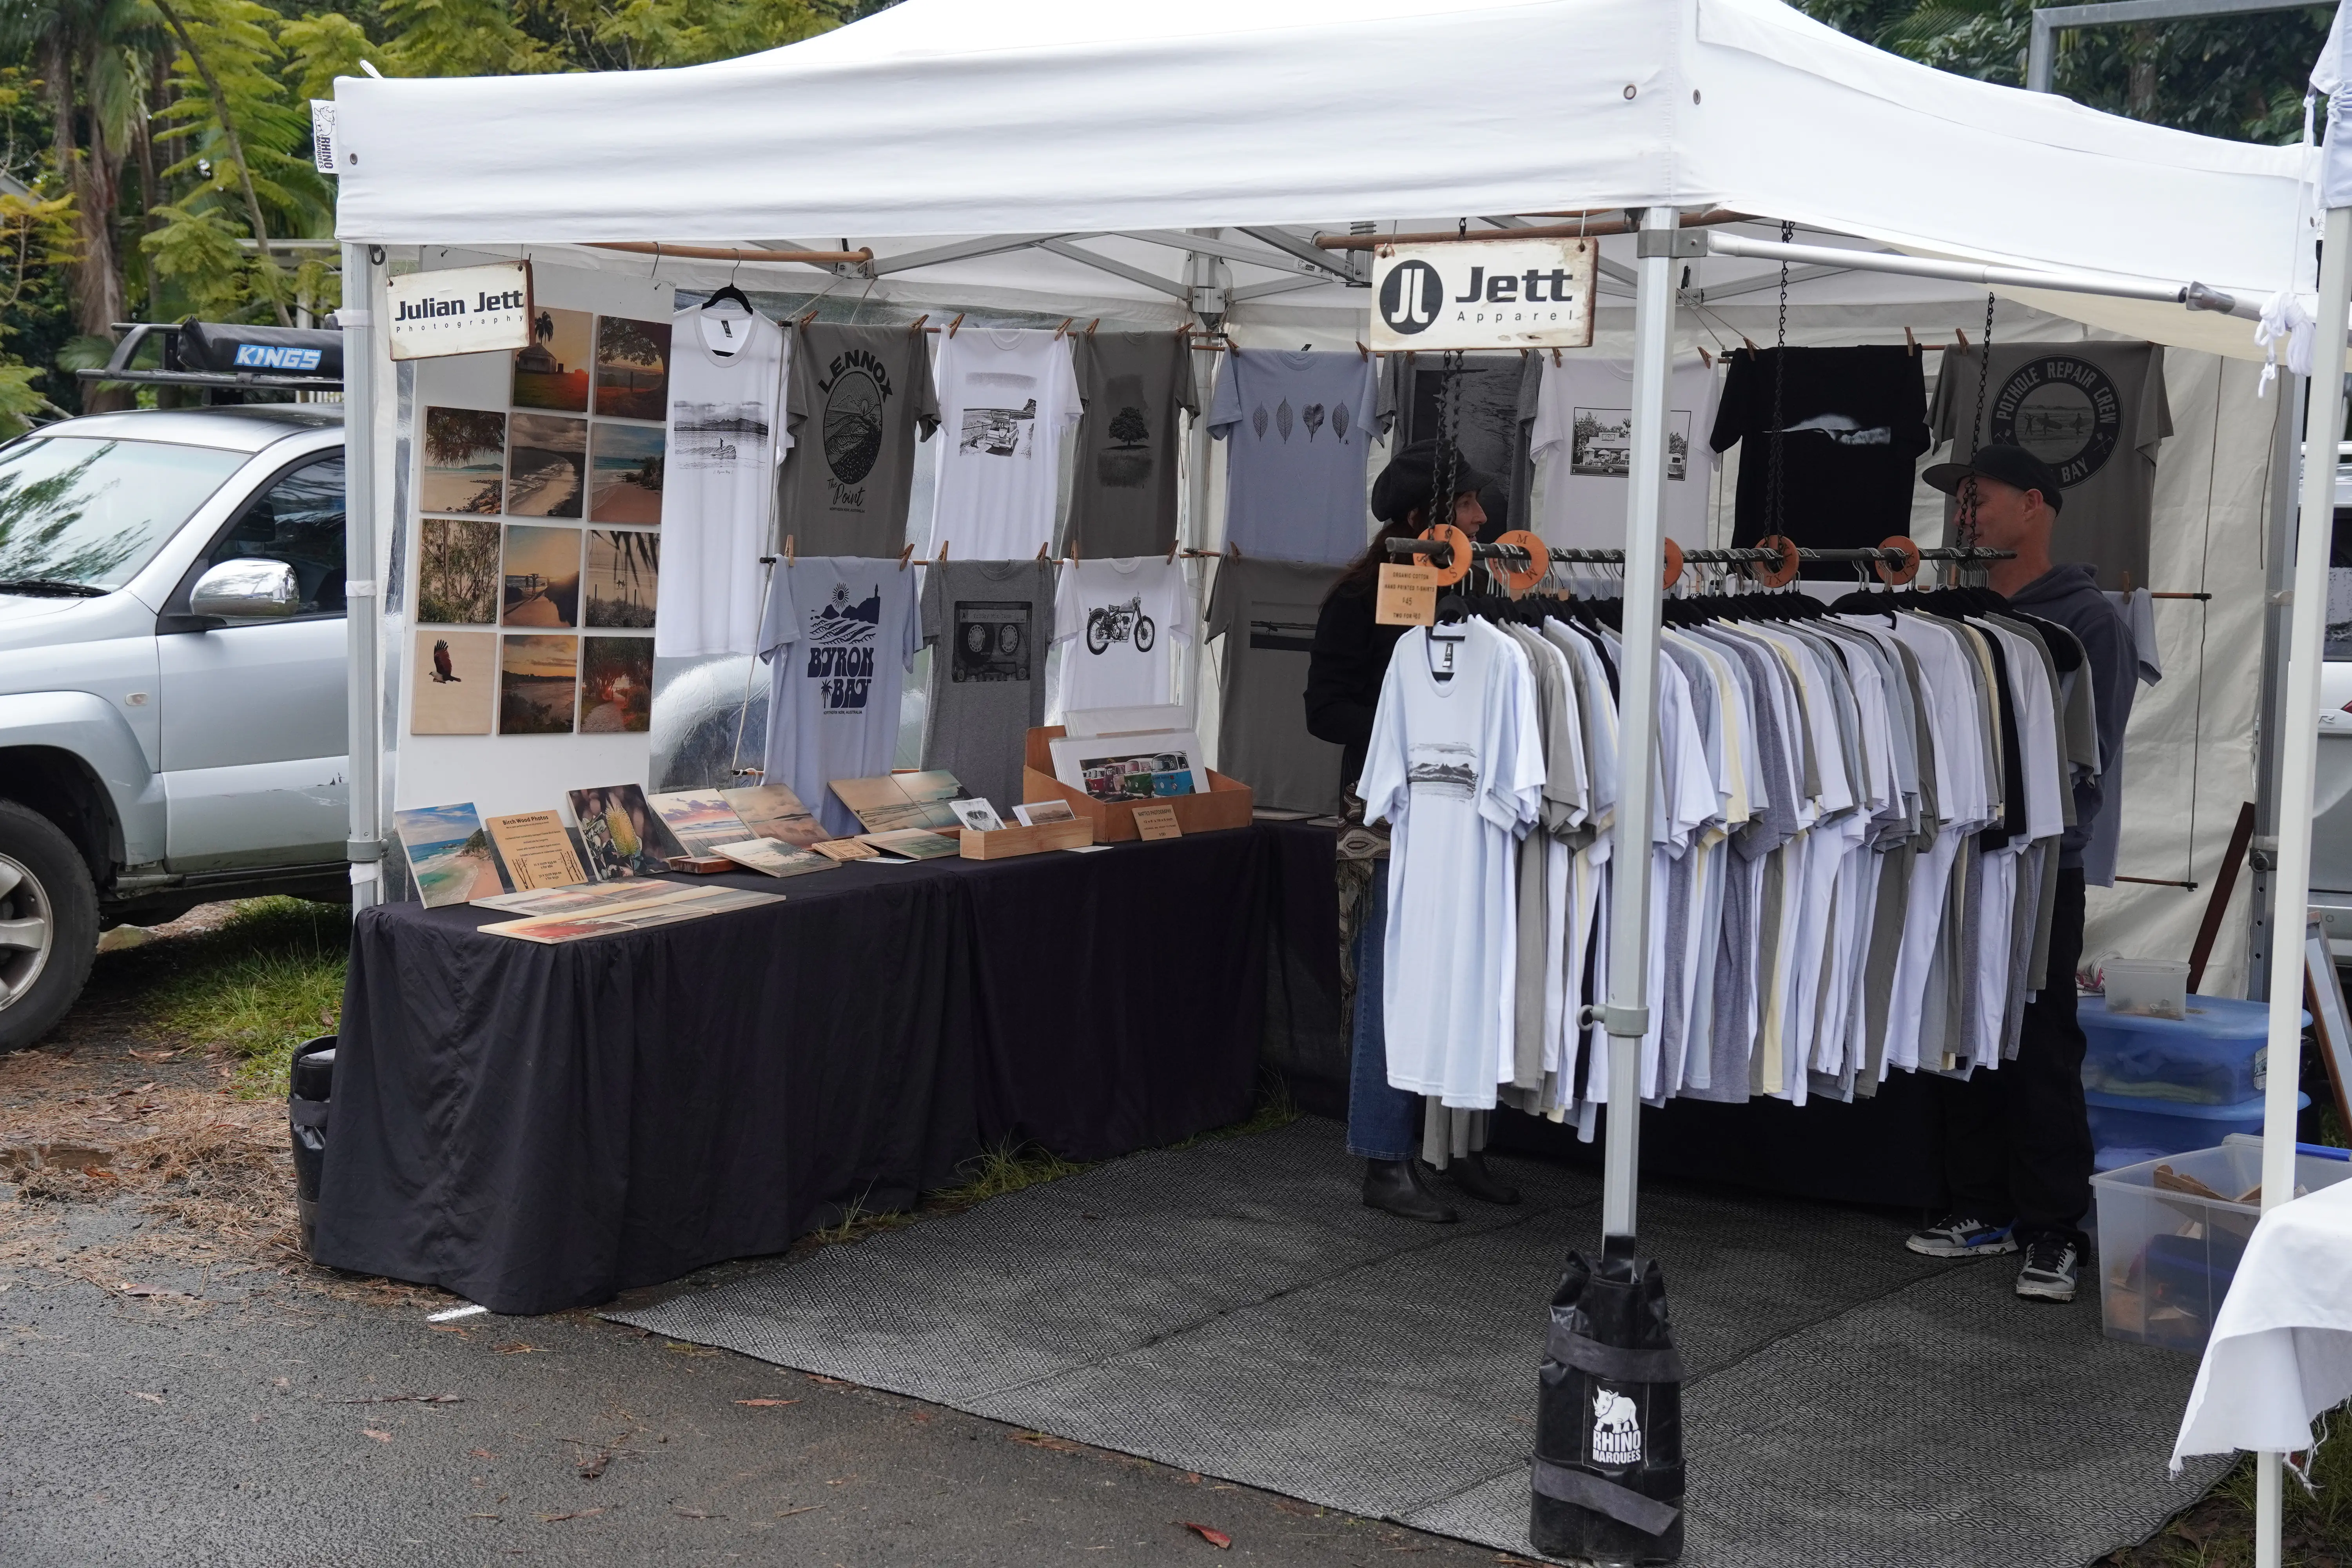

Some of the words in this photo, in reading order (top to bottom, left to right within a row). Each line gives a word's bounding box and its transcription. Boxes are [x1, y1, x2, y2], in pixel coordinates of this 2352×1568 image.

[316, 136, 324, 169] MARQUEES
[321, 137, 334, 169] RHINO
[1455, 266, 1573, 303] Jett
[395, 298, 465, 321] Julian
[474, 290, 524, 312] Jett
[1457, 310, 1572, 322] Apparel
[396, 314, 523, 333] Photography
[236, 347, 319, 368] KINGS
[818, 349, 893, 403] LENNOX
[1996, 367, 2040, 420] POTHOLE
[2047, 361, 2097, 388] REPAIR
[2093, 387, 2116, 424] CREW
[2061, 457, 2088, 483] BAY
[827, 477, 838, 490] The
[833, 483, 866, 506] Point
[1516, 534, 1528, 544] M
[1449, 567, 1457, 578] S
[1525, 568, 1537, 580] M
[1402, 597, 1413, 606] $45
[808, 647, 874, 677] BYRON
[830, 679, 871, 708] BAY
[1593, 1429, 1641, 1452] RHINO
[1593, 1448, 1641, 1465] MARQUEES
